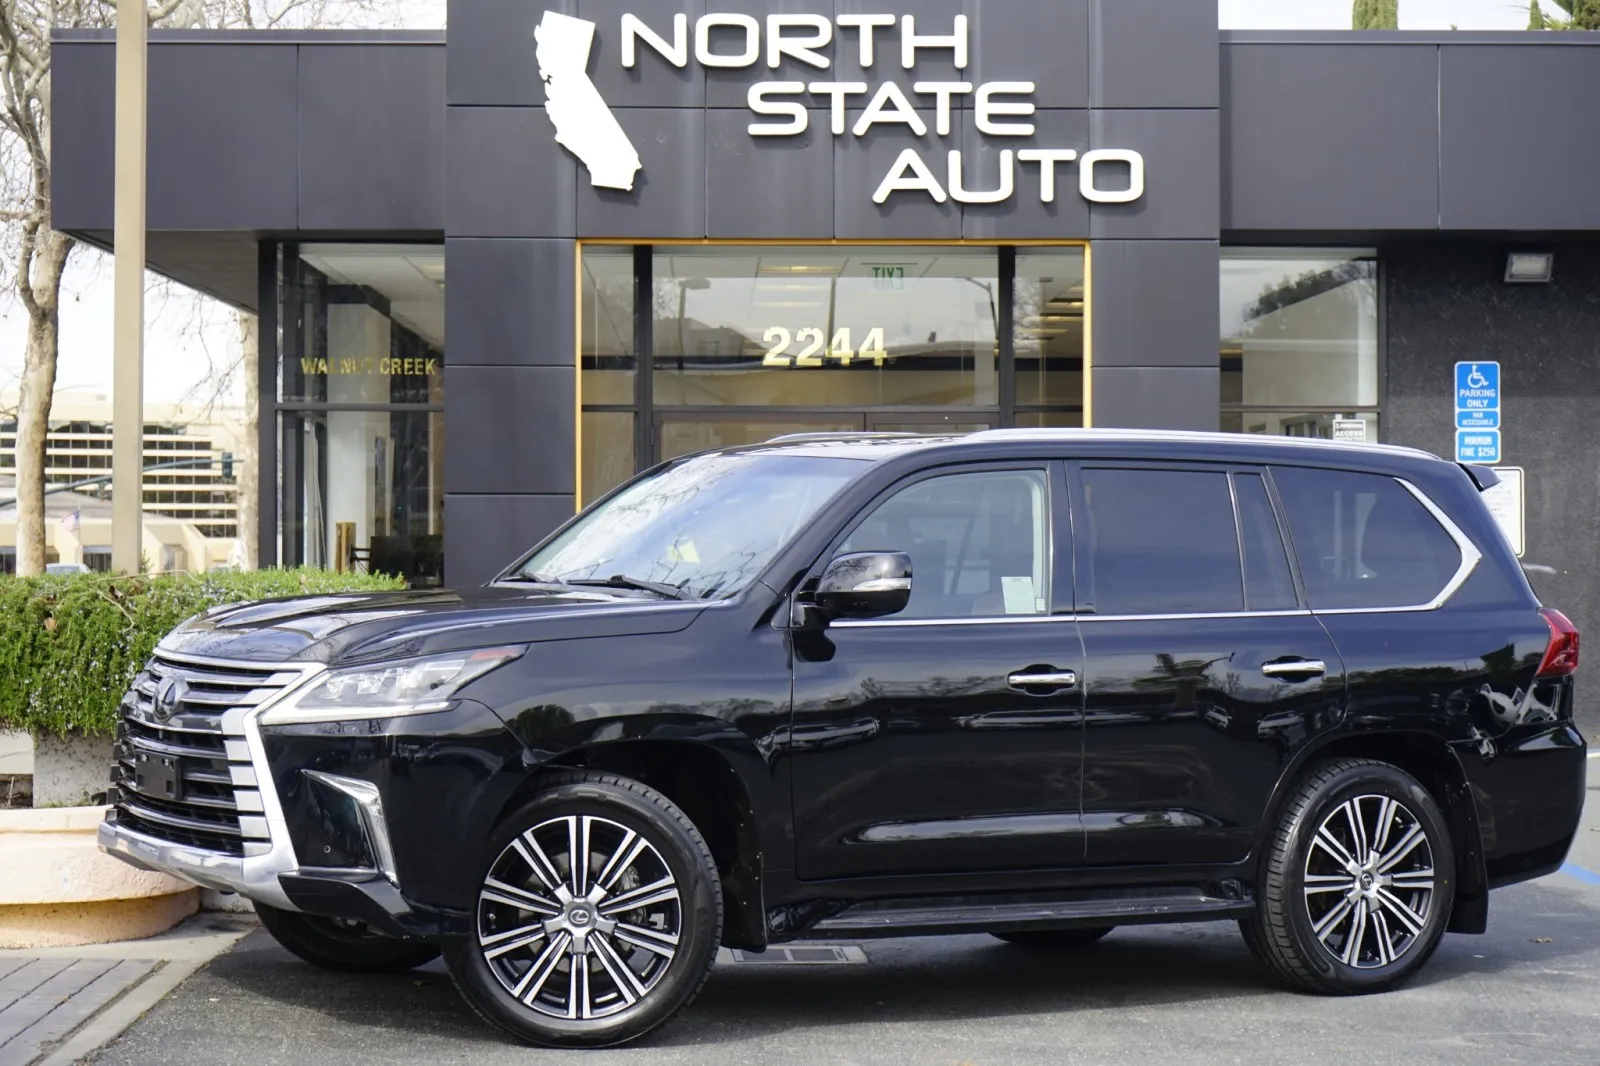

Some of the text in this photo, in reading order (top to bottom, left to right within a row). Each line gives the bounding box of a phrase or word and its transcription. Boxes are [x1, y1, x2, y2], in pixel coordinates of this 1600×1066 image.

[621, 13, 967, 68] NORTH
[748, 81, 1035, 136] STATE
[872, 148, 1144, 203] AUTO
[762, 326, 888, 366] 2244
[379, 357, 436, 375] CREEK
[1459, 388, 1496, 398] PARKING
[1466, 399, 1489, 408] ONLY
[1460, 446, 1496, 457] FINE $250
